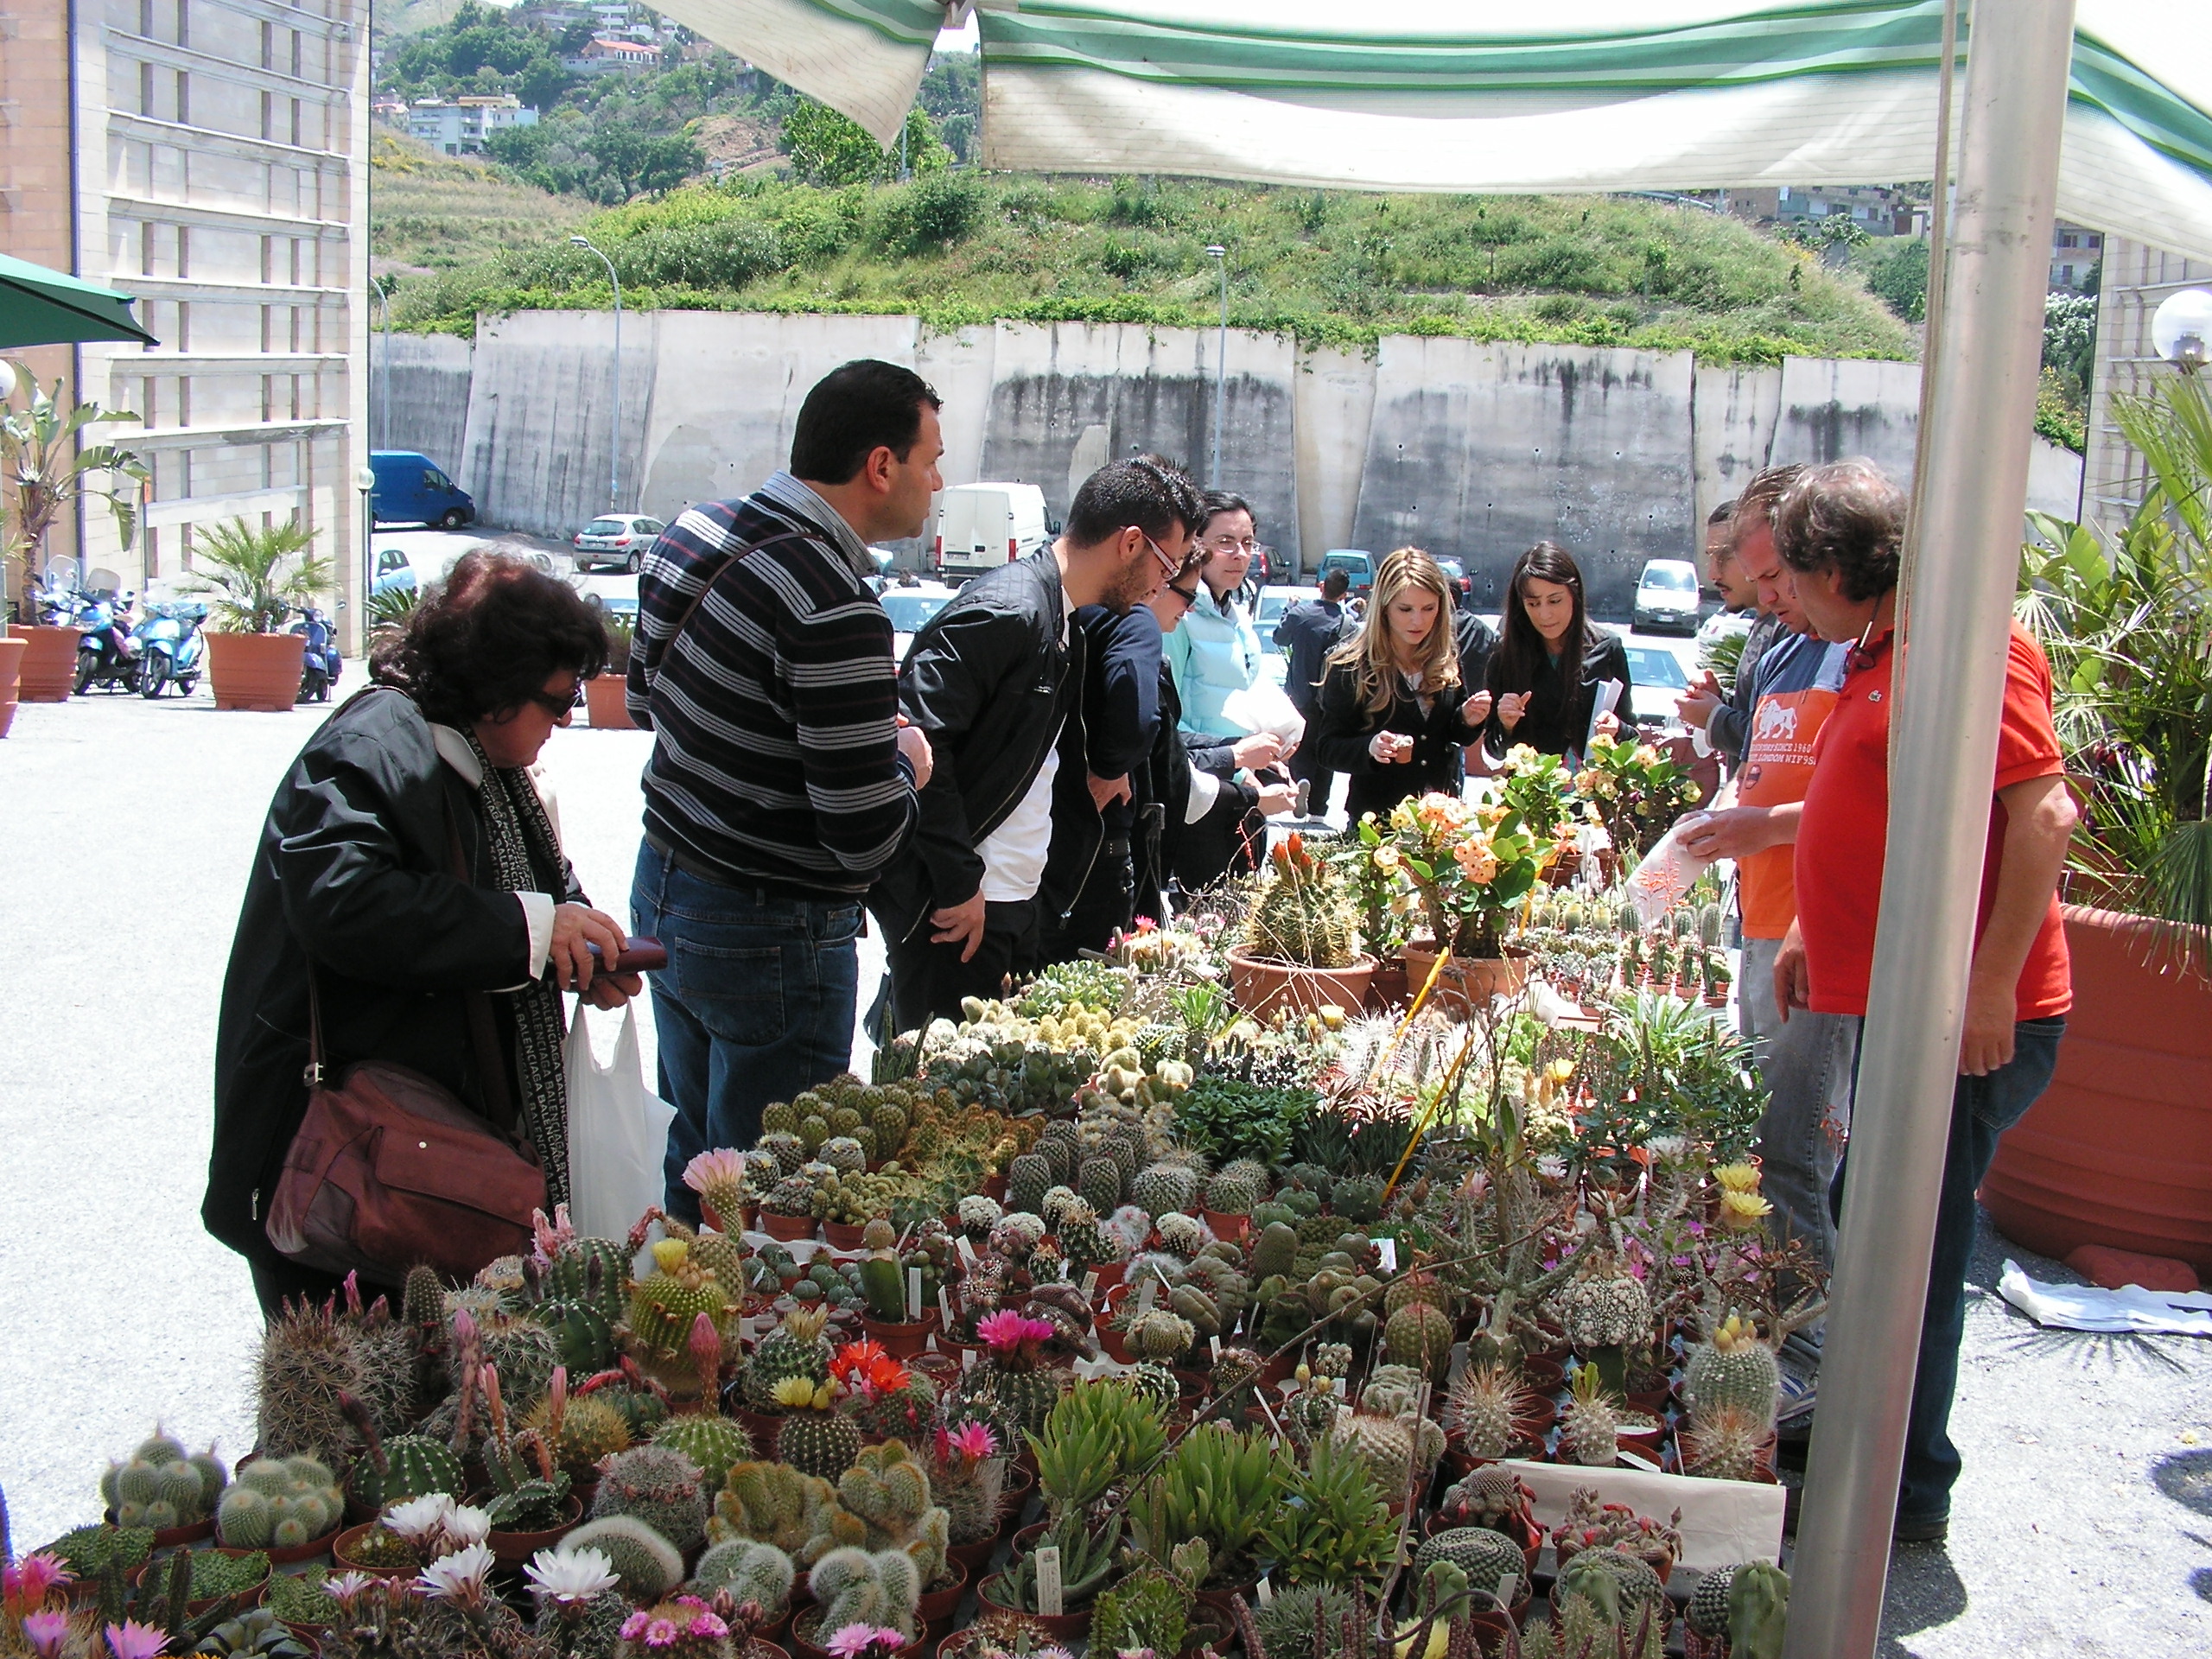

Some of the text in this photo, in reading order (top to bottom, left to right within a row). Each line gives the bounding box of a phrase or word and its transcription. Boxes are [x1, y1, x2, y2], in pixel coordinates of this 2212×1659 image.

[1793, 743, 1812, 753] 1960
[528, 1000, 556, 1078] BALENCIAGA
[544, 1081, 565, 1158] BALENCIAGA
[539, 992, 565, 1071] BALENCIAGA
[516, 1013, 543, 1092] BALENCIAGA
[537, 1094, 561, 1173] BALENCIAGA
